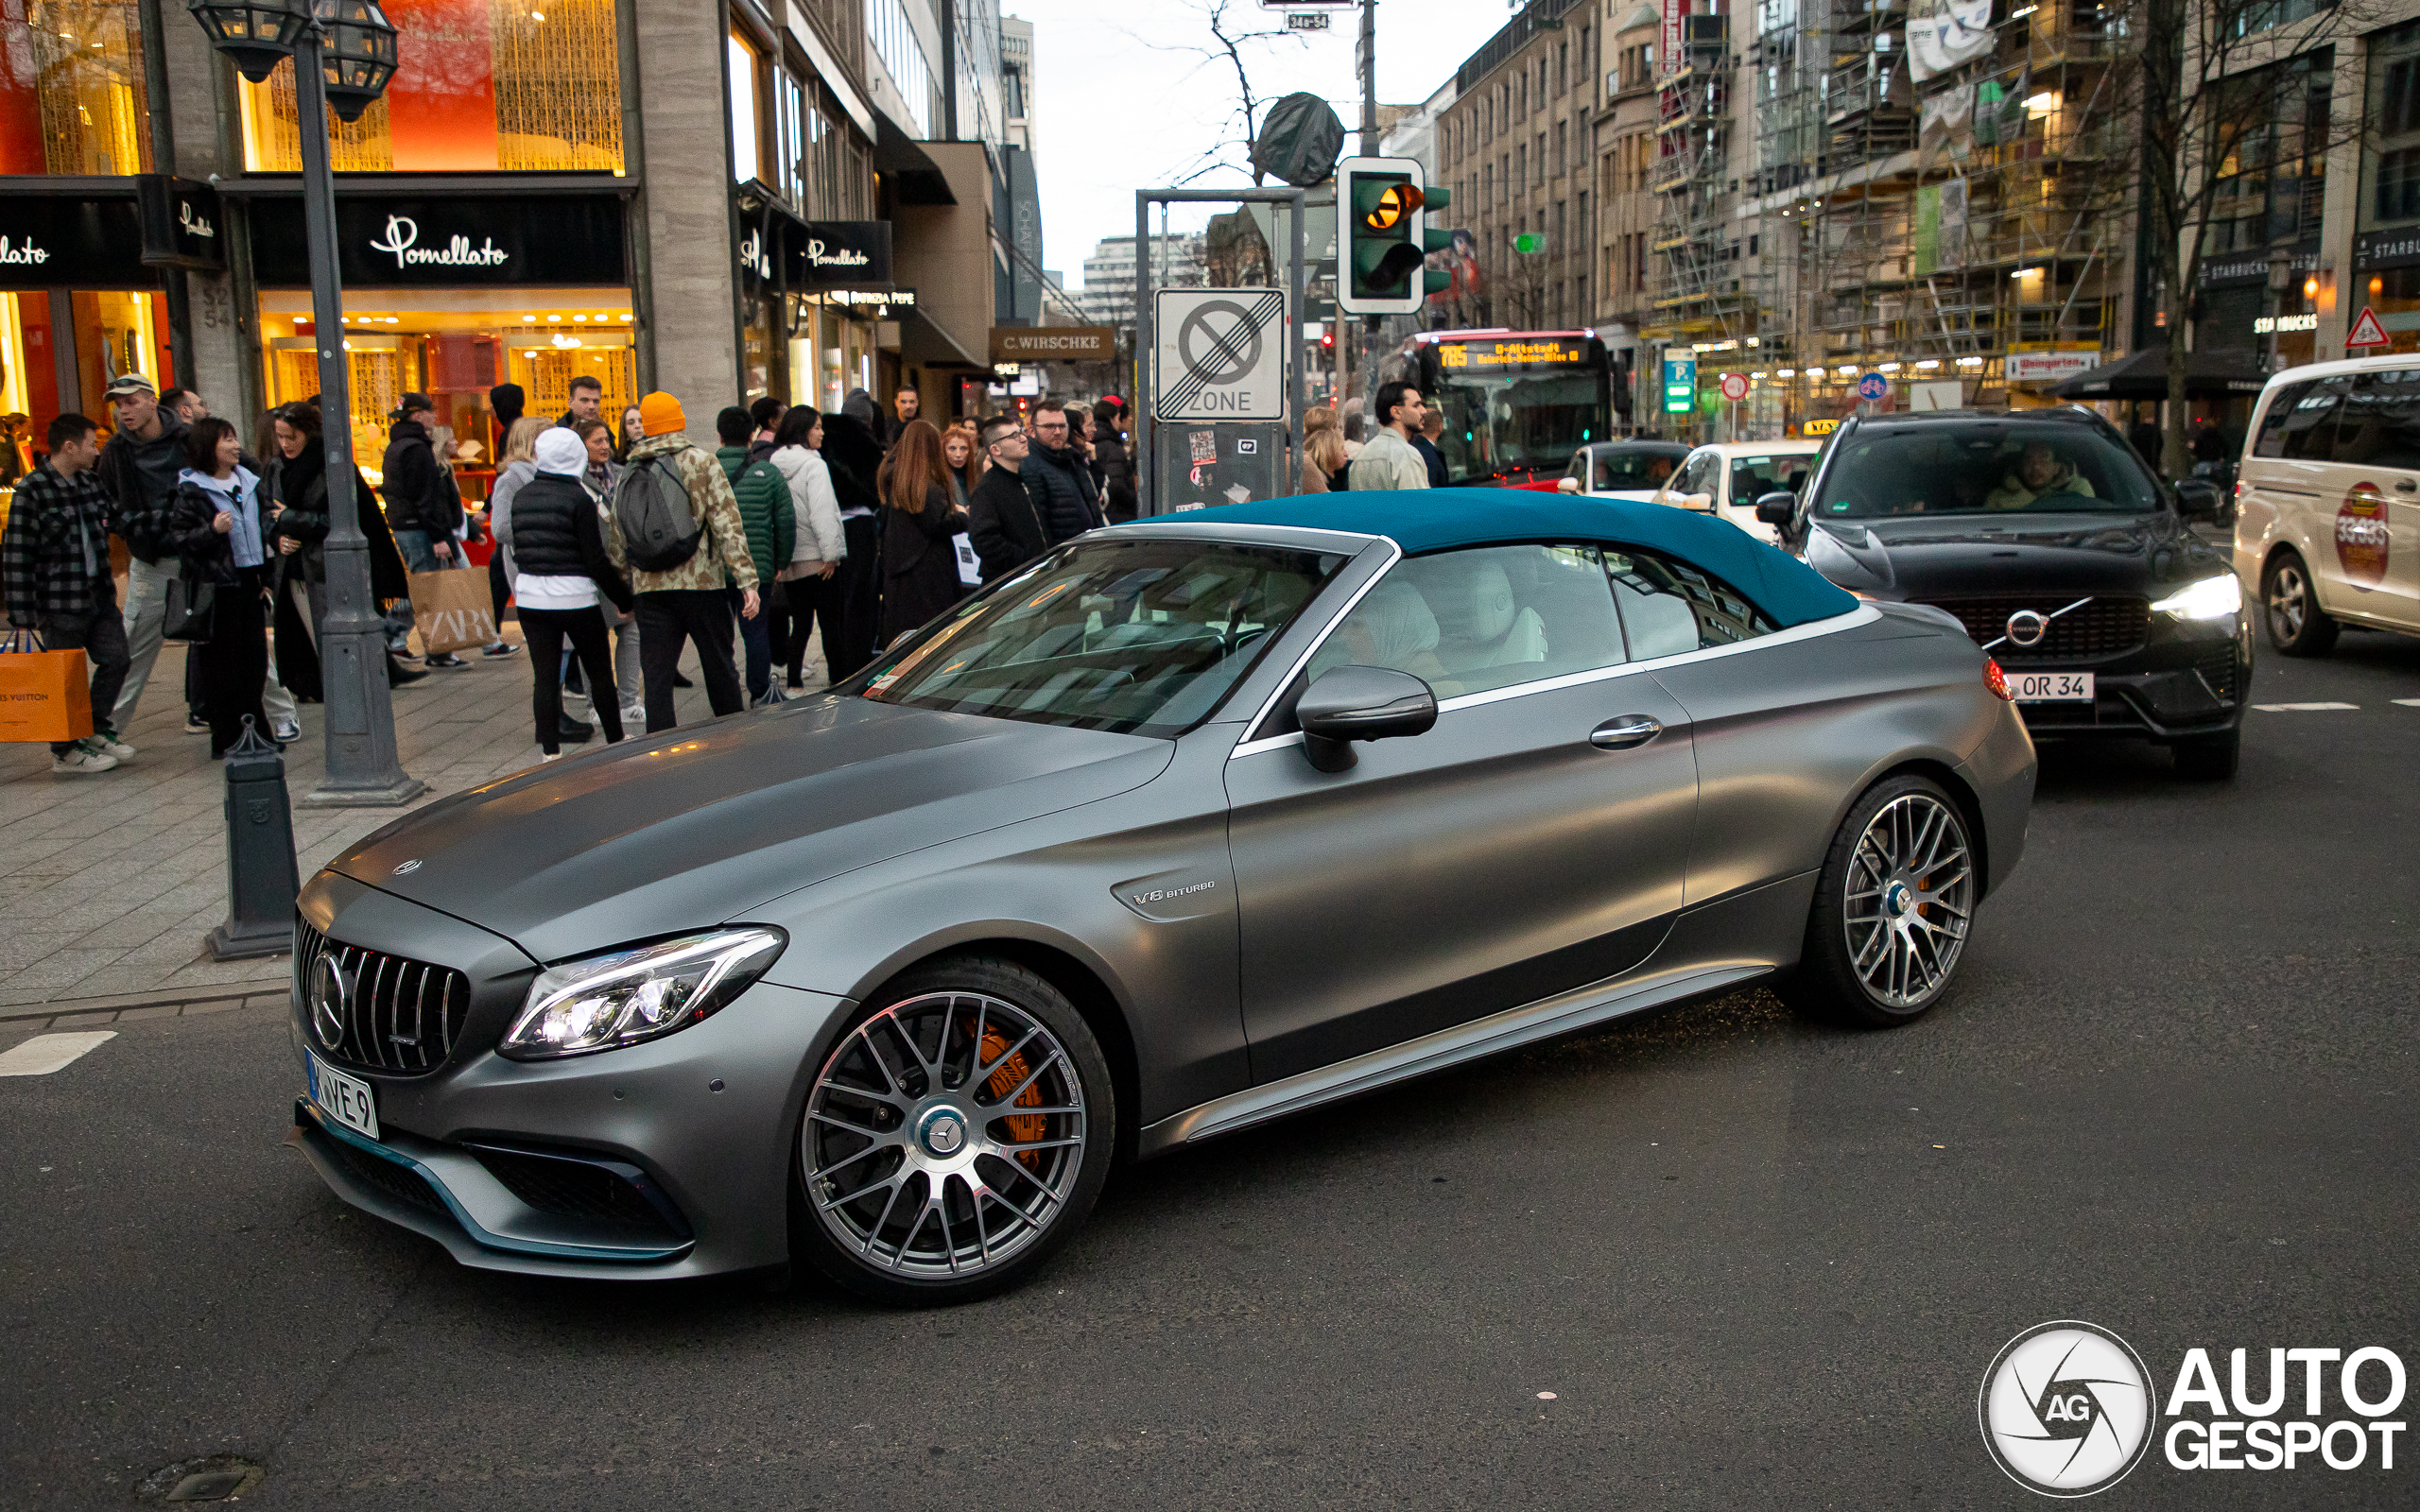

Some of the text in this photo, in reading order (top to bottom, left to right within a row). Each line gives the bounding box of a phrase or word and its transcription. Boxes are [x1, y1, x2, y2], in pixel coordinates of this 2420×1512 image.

[370, 214, 510, 269] Pomellato
[800, 238, 870, 266] Pomellato
[1439, 345, 1467, 367] 785
[1189, 391, 1251, 411] ZONE
[2023, 677, 2084, 696] OR 34
[1133, 881, 1216, 905] V8 BITURBO
